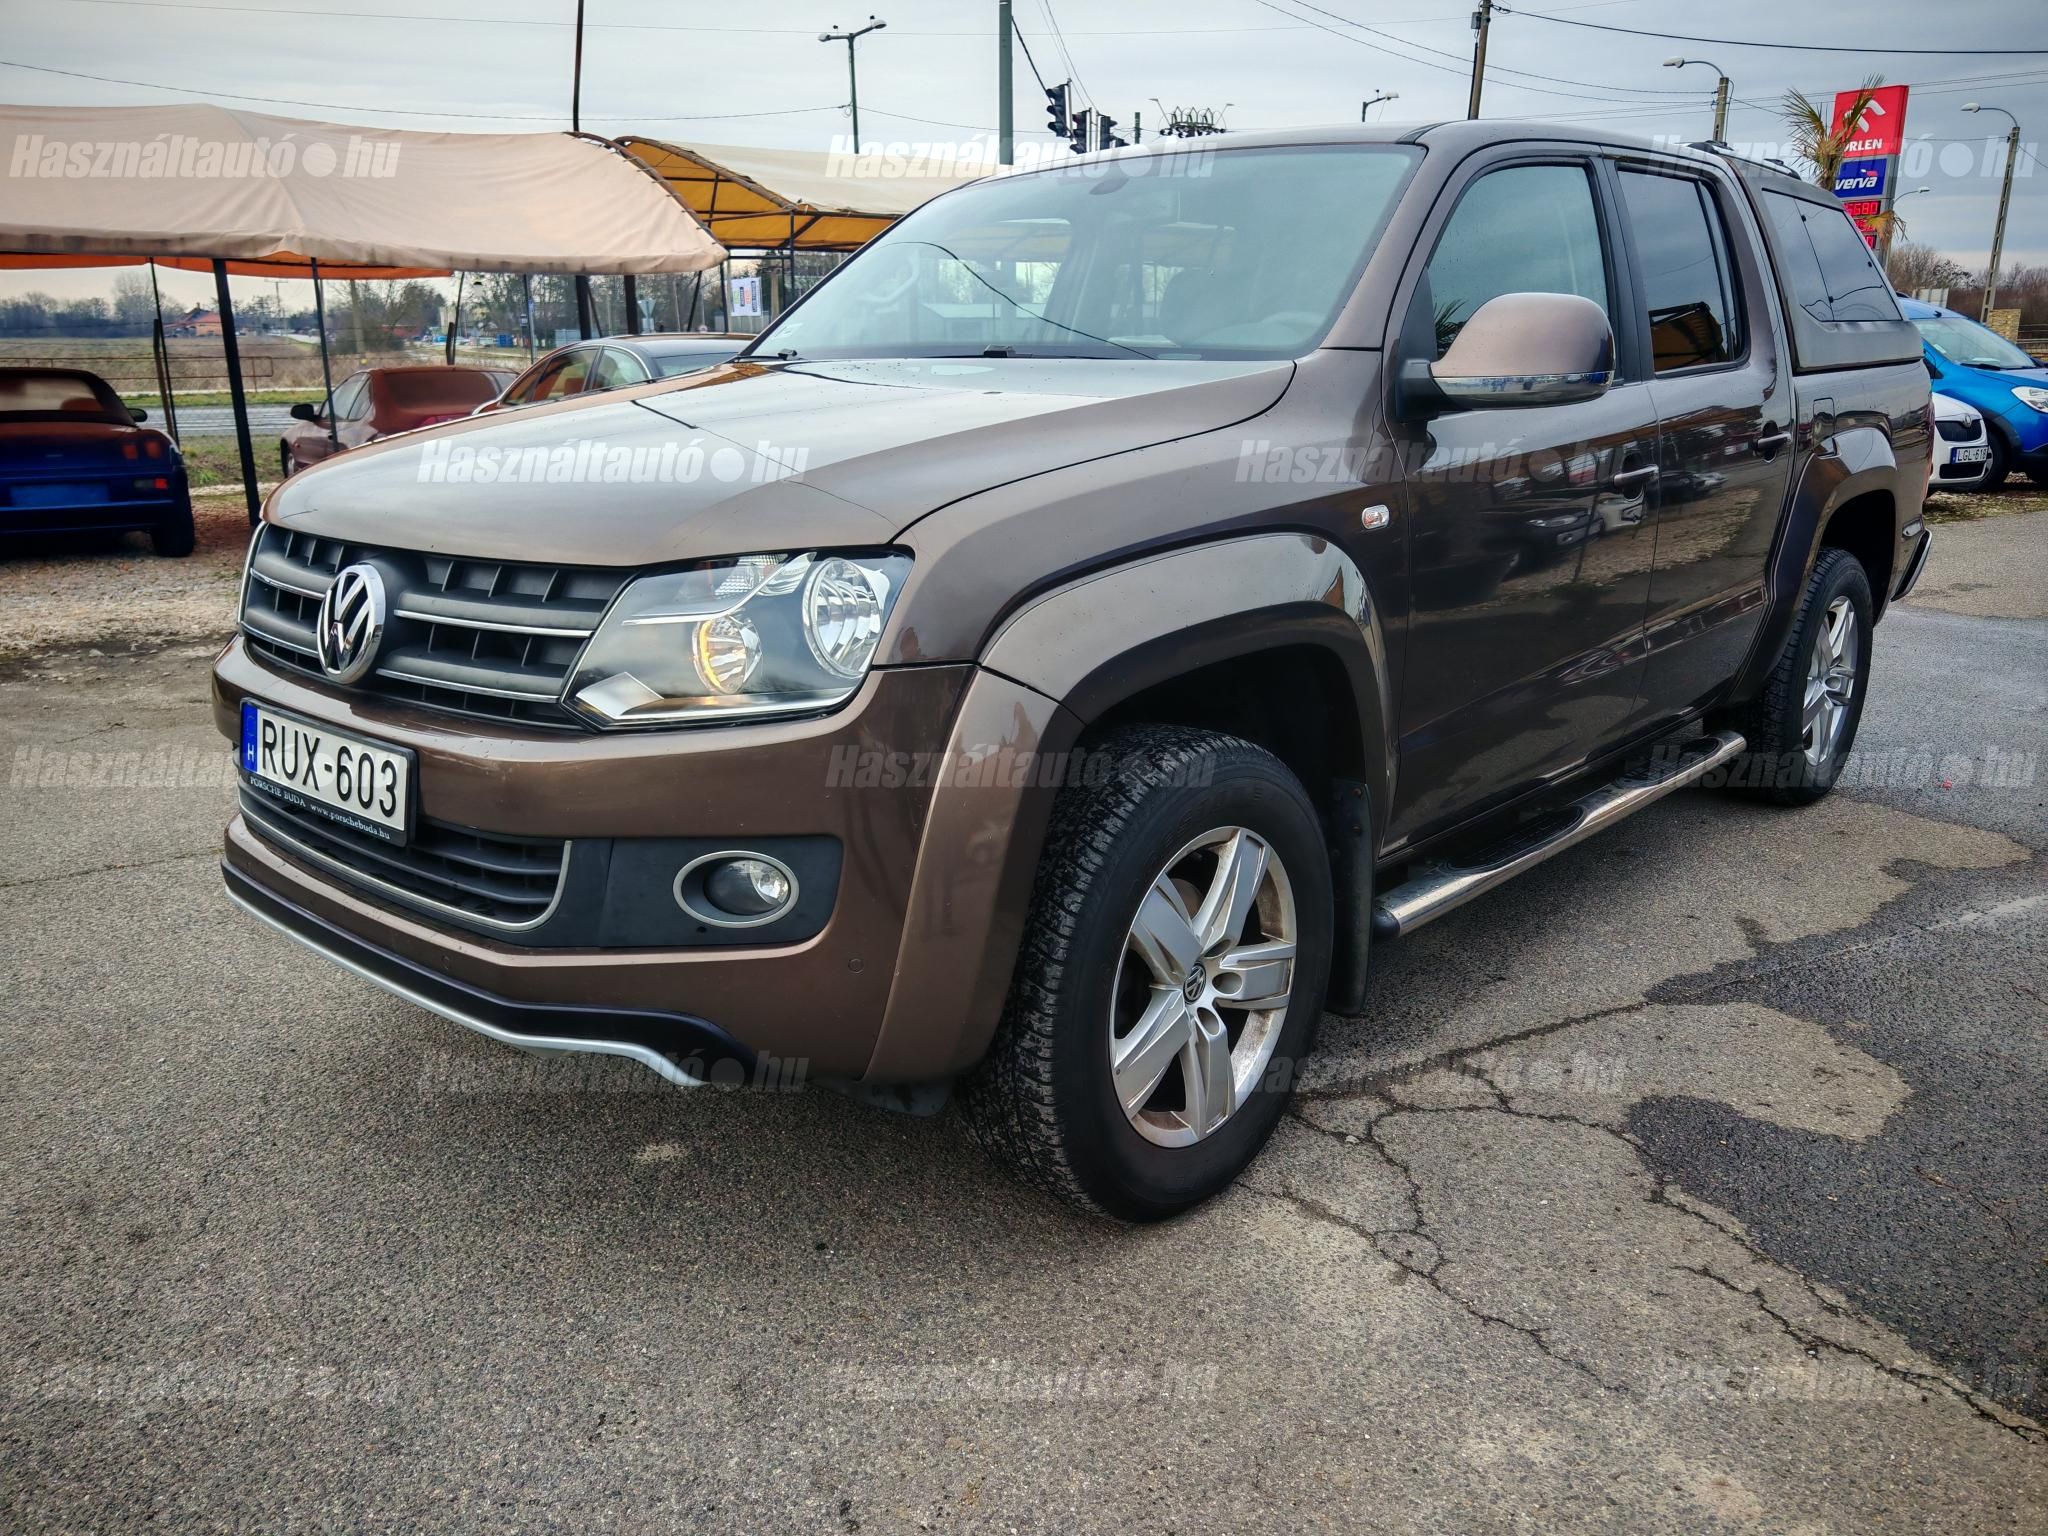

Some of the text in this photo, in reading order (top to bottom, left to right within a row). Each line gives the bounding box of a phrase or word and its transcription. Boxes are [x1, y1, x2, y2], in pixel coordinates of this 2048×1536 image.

[1835, 176, 1878, 190] verva
[262, 718, 397, 818] RUX-603
[250, 777, 391, 841] PORSCHE BUDA www.porschebuda.hu
